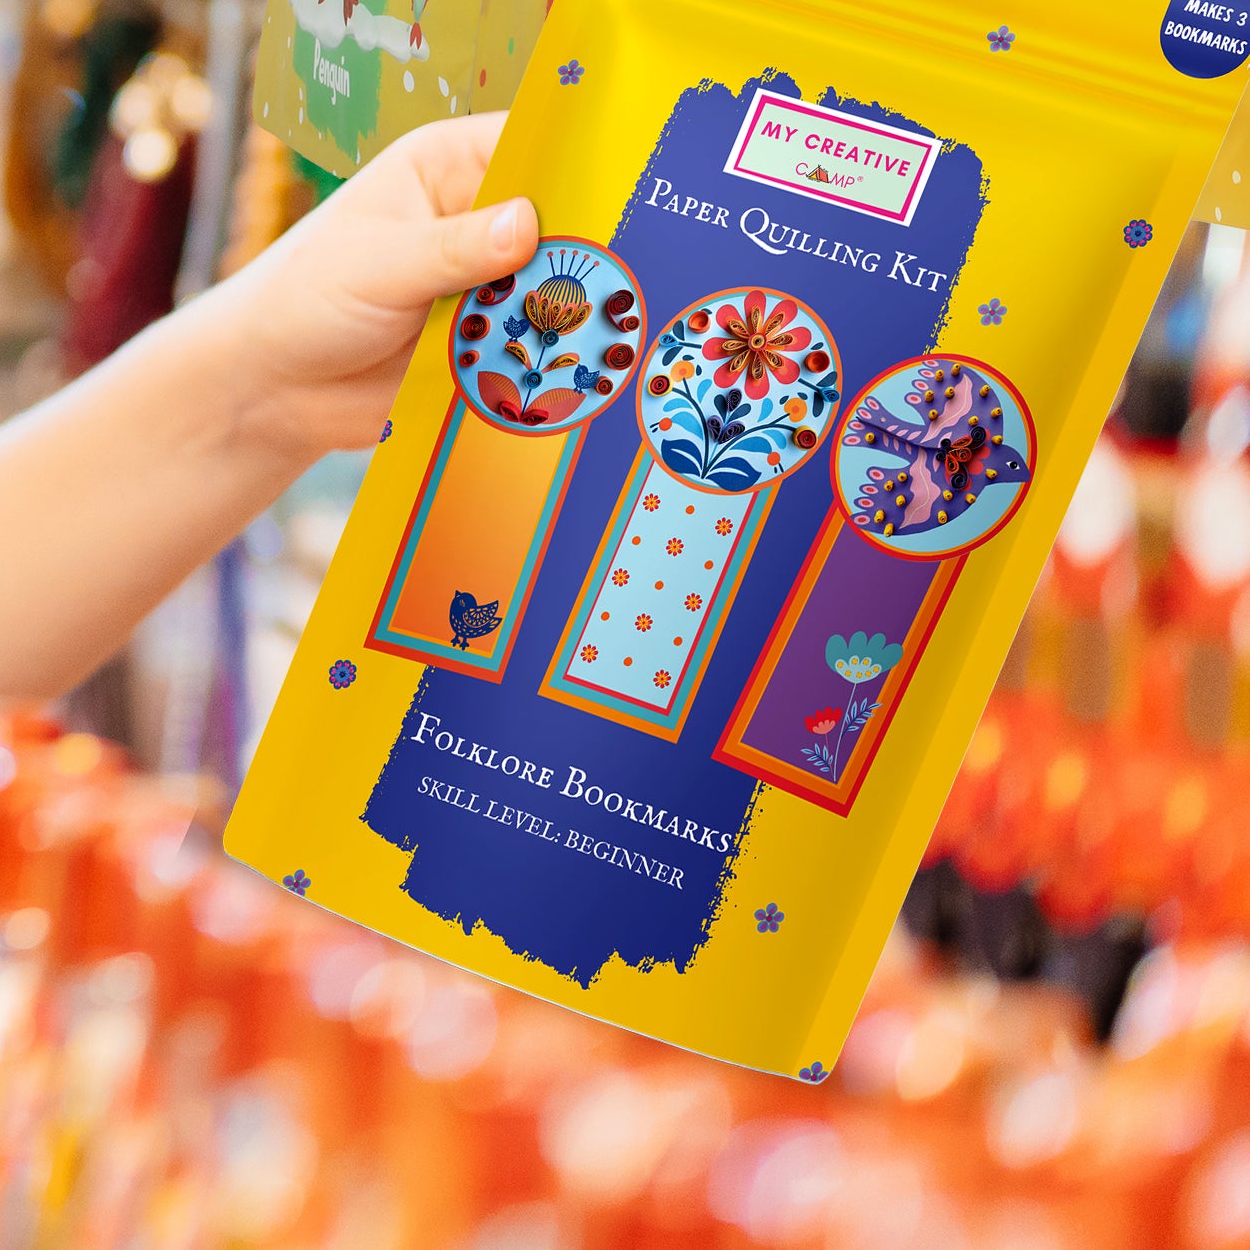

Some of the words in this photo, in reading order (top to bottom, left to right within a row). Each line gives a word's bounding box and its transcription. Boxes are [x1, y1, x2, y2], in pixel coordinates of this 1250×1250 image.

[1164, 20, 1249, 55] BOOKMARKS
[1236, 11, 1249, 26] 3
[313, 37, 350, 106] Penguin
[760, 120, 799, 143] MY
[804, 133, 911, 178] CREATIVE
[645, 177, 730, 229] PAPER
[739, 206, 882, 274] QUILLING
[886, 250, 948, 293] KIT
[410, 711, 555, 789] FOLKLORE
[558, 765, 733, 854] BOOKMARKS
[417, 775, 482, 814] SKILL
[482, 800, 561, 844] LEVEL:
[563, 828, 685, 890] BEGINNER
